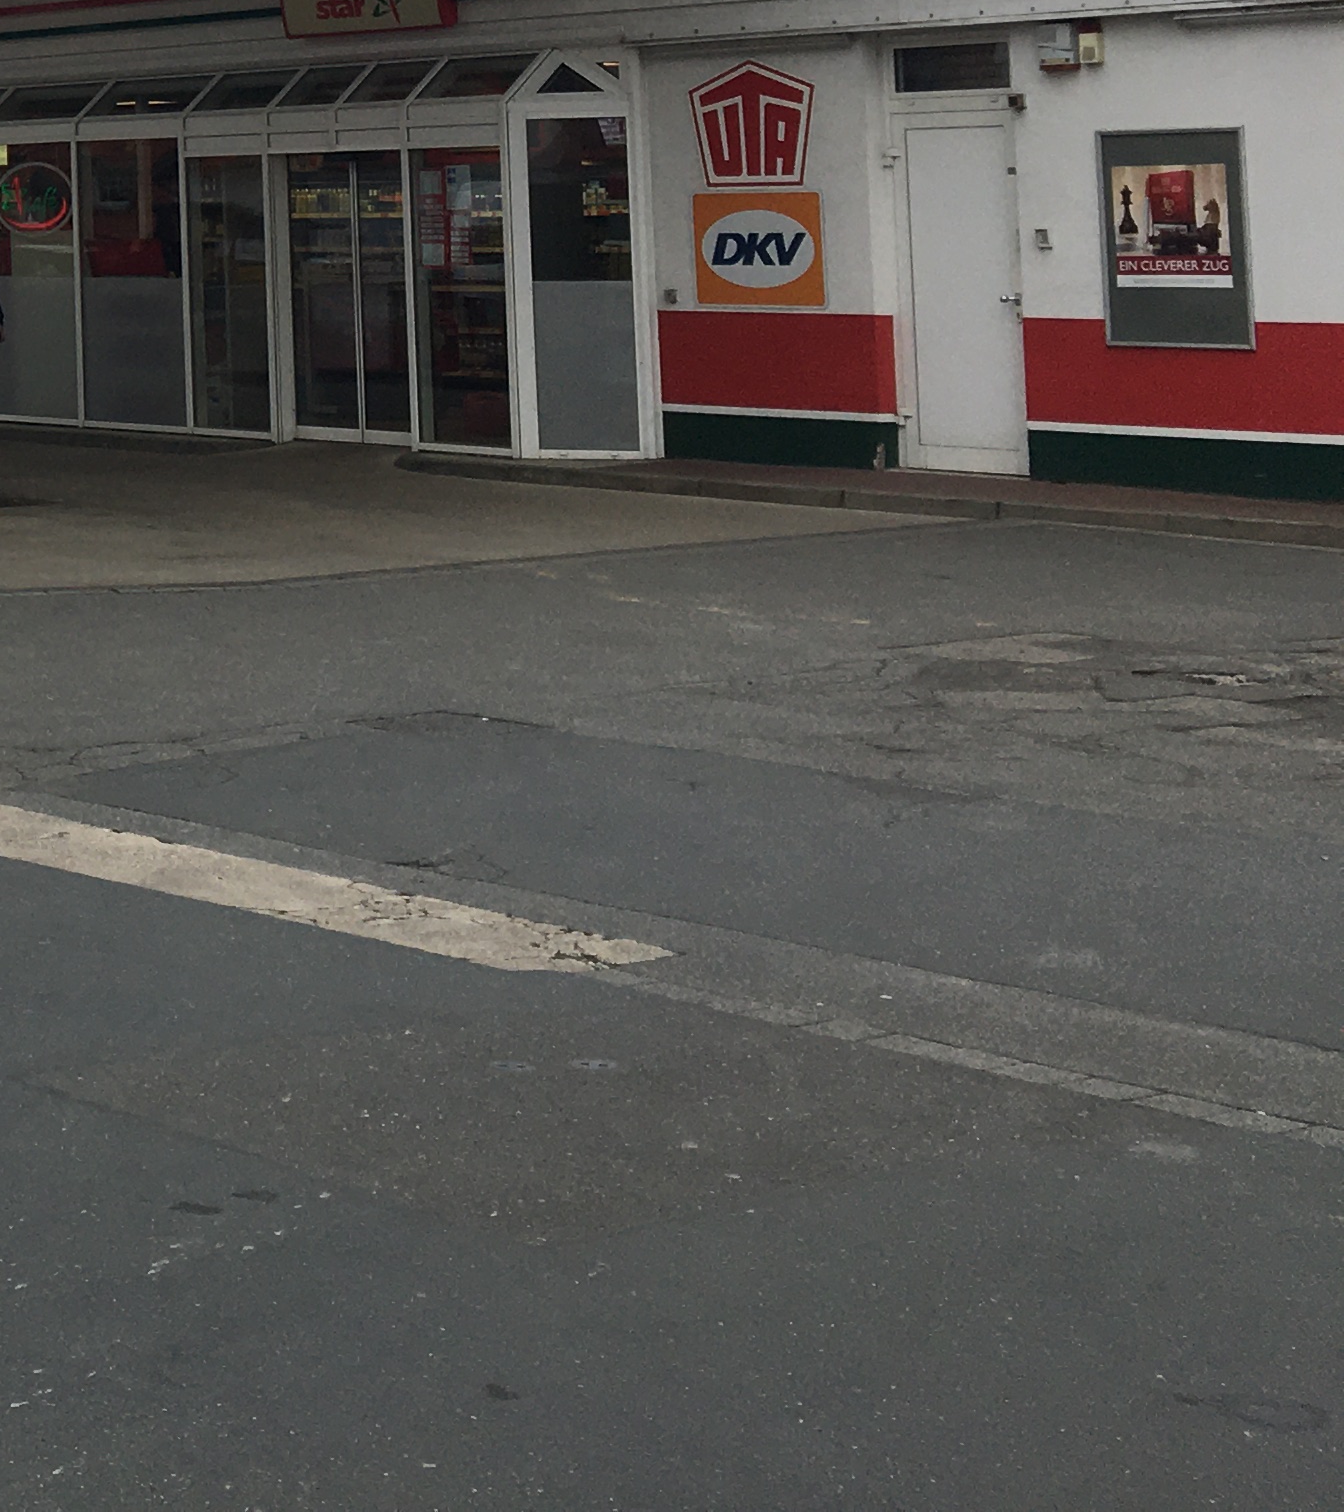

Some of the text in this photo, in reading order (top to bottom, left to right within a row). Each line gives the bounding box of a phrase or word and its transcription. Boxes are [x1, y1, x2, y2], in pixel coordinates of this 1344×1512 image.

[698, 69, 805, 177] UTA
[712, 232, 806, 266] DKV
[1118, 259, 1229, 271] EIN CLEVERER ZUG
